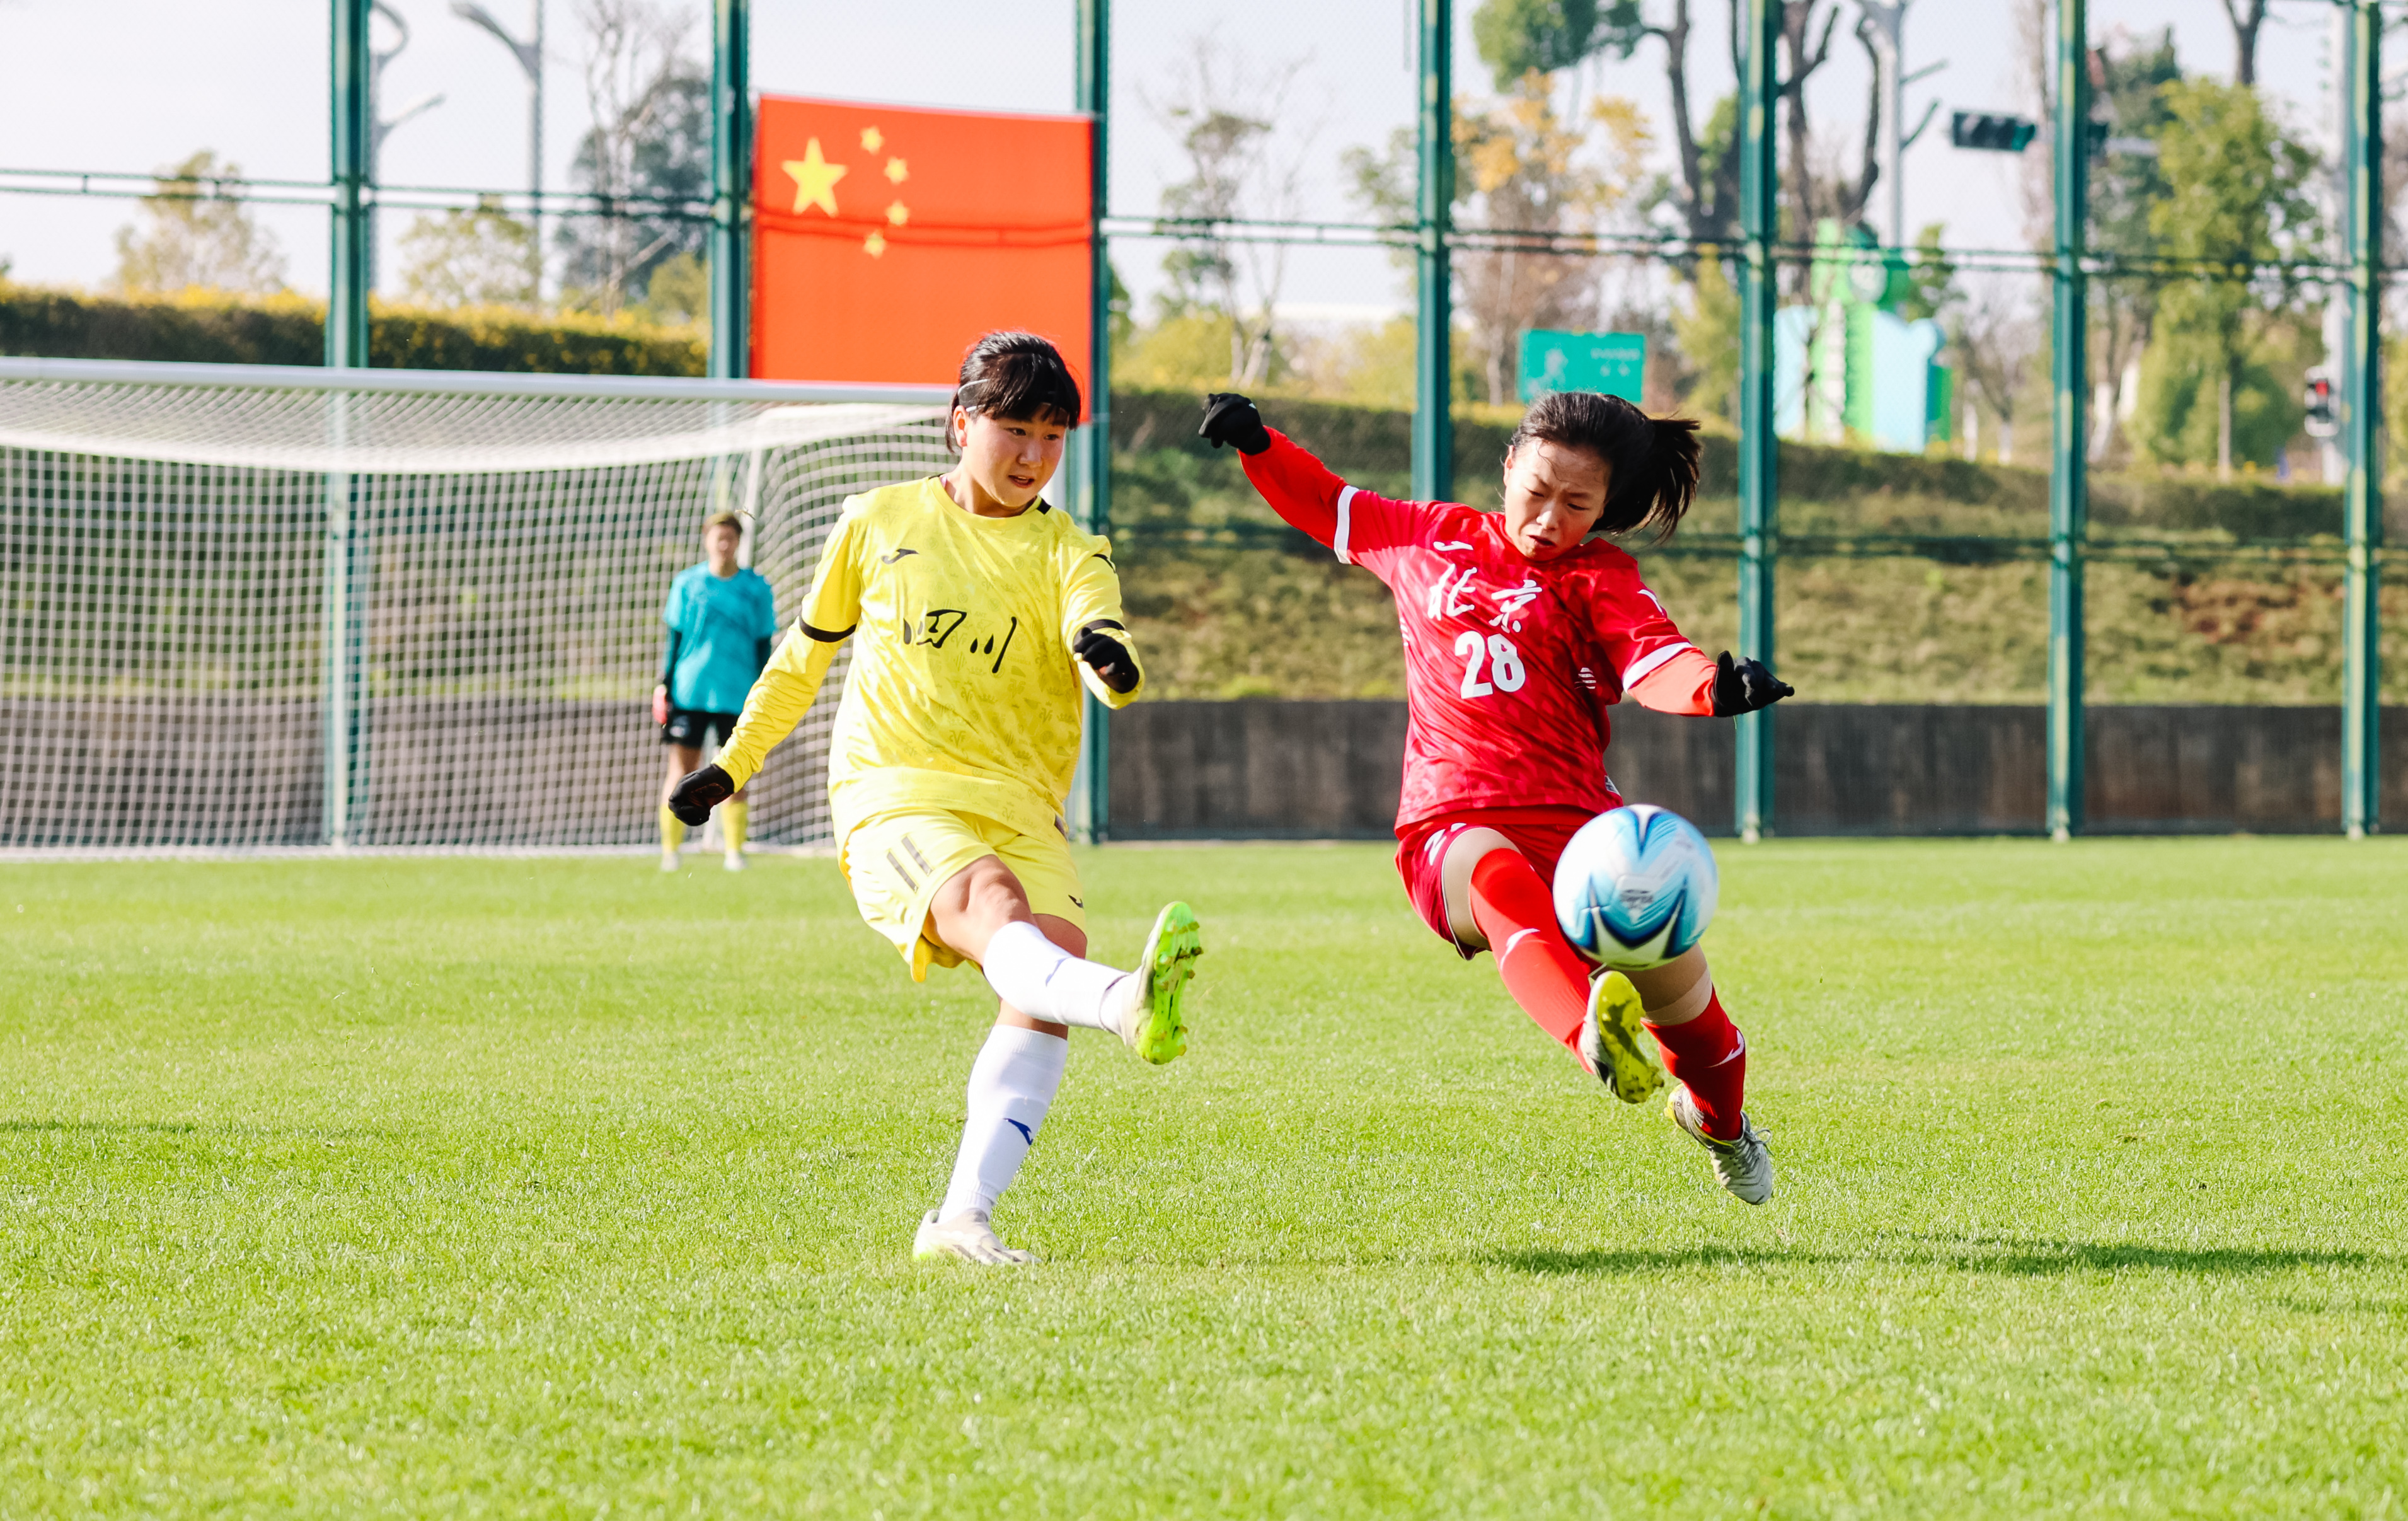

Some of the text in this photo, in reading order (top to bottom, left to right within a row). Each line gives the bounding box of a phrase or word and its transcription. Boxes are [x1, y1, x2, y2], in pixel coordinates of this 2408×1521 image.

[1427, 564, 1543, 633] 北京
[903, 609, 1017, 674] 四川
[1455, 631, 1526, 699] 28
